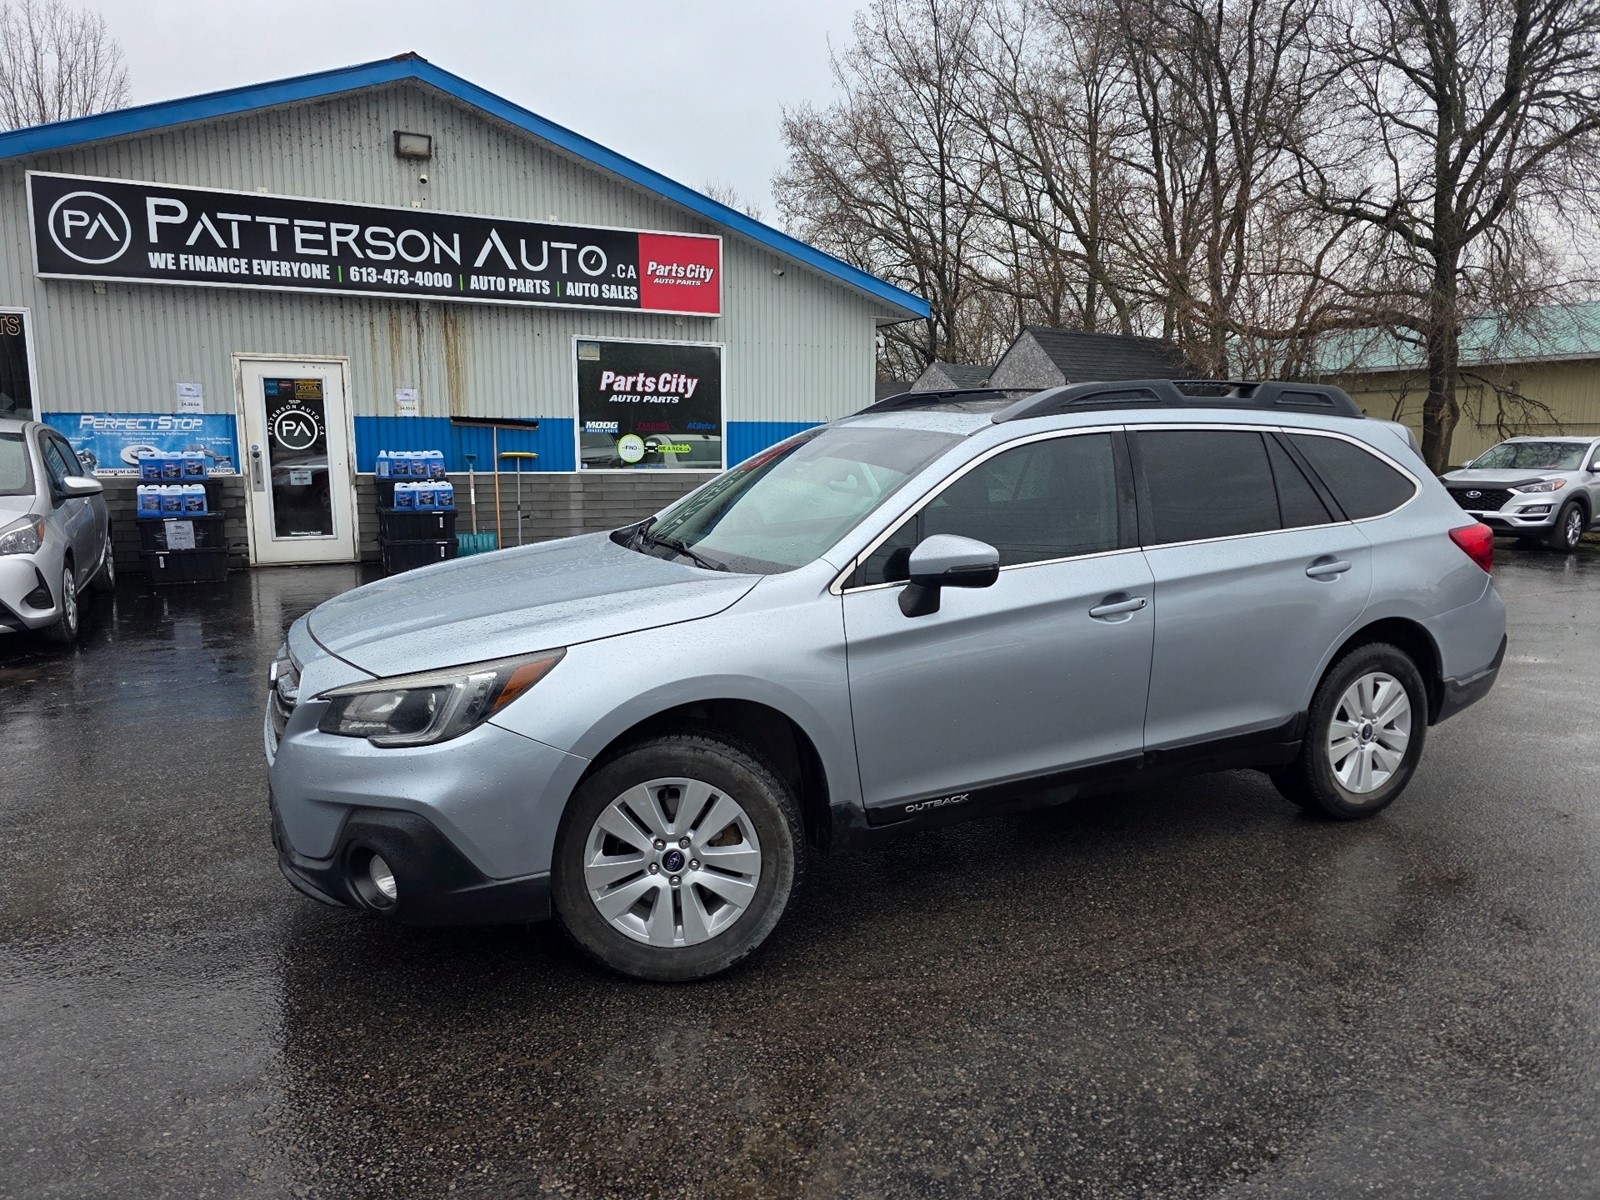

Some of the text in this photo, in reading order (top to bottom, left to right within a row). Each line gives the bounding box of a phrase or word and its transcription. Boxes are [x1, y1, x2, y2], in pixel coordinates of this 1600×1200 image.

[146, 196, 461, 267] PATTERSON
[147, 251, 331, 281] WE FINANCE EVERYONE
[349, 265, 454, 289] 613-473-4000
[469, 274, 551, 295] AUTO PARTS
[653, 277, 702, 286] AUTO PARTS
[565, 281, 639, 301] AUTO SALES
[608, 394, 680, 404] AUTO PARTS
[267, 404, 297, 436] PATTERSON
[281, 420, 312, 437] PA
[585, 421, 619, 430] MOOG
[905, 793, 970, 812] OUTBACK
